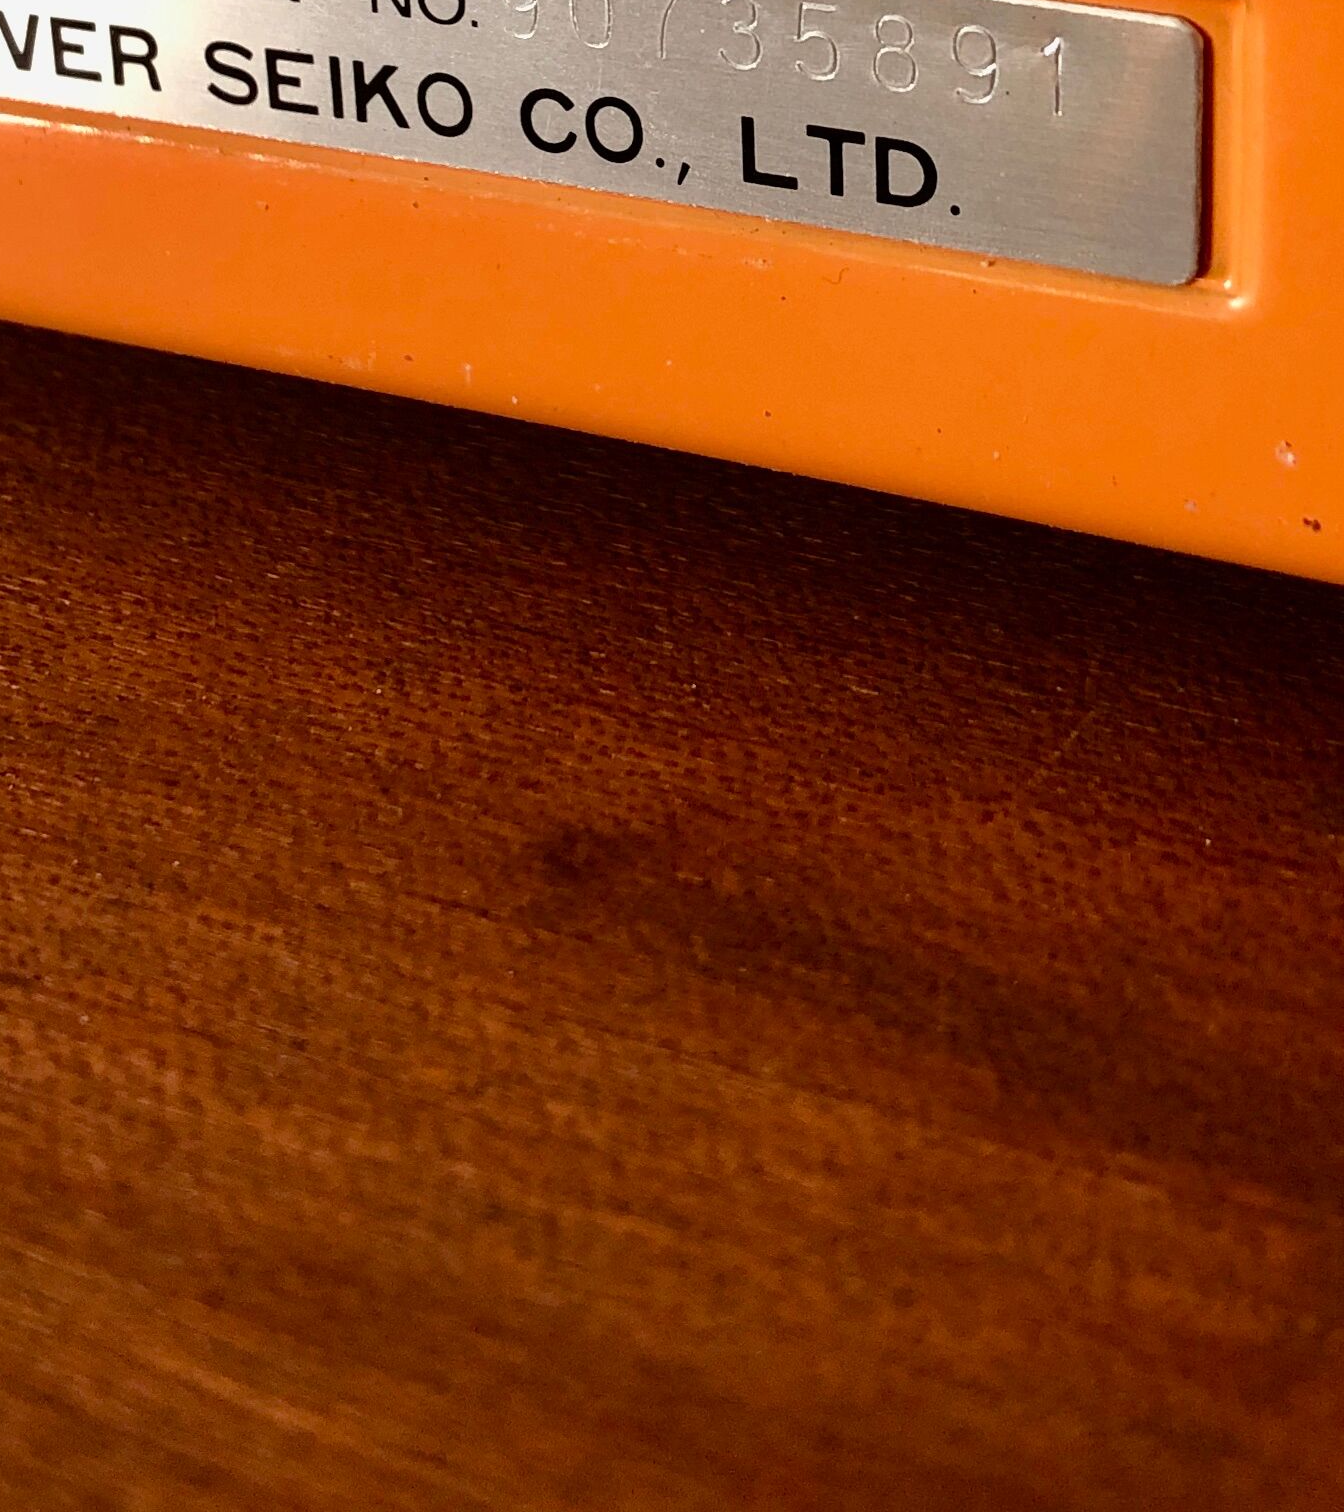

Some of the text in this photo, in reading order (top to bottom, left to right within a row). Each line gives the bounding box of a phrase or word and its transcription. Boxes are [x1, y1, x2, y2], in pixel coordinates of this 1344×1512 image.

[203, 40, 475, 138] SEIKO
[519, 87, 691, 187] CO.,
[740, 115, 962, 217] LTD.
